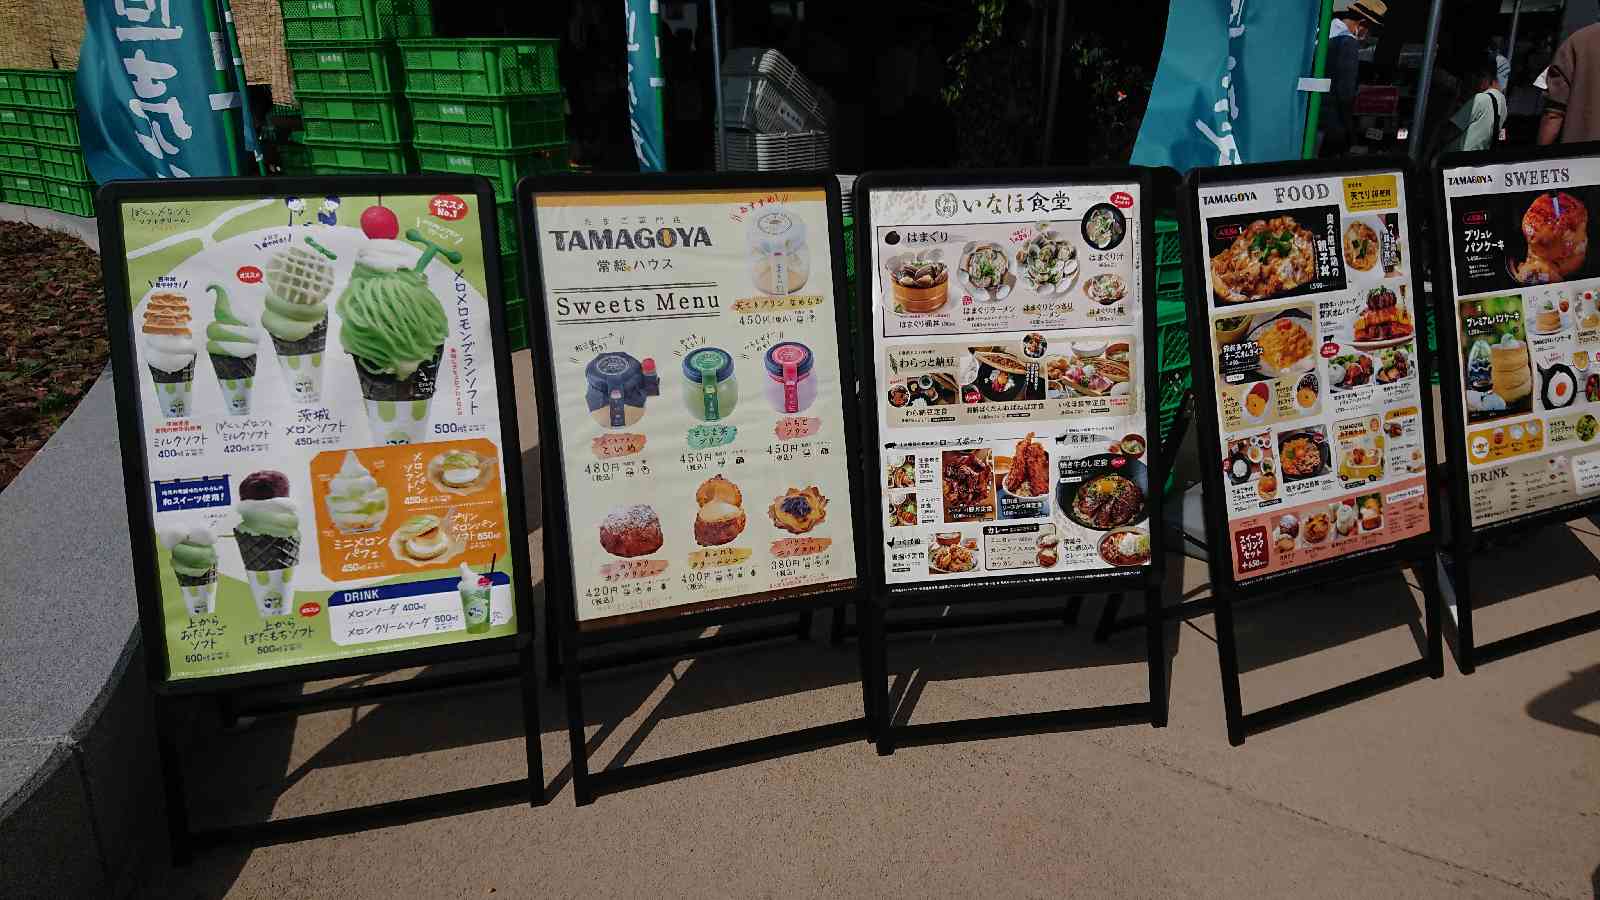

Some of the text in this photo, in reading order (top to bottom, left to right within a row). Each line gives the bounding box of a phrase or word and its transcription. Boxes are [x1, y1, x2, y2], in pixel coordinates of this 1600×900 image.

[1448, 174, 1493, 186] TAMAGOYA
[1504, 167, 1570, 188] SWEETS
[1202, 190, 1258, 205] TAMAGOYA
[1273, 183, 1331, 204] FOOD
[963, 191, 1073, 215] いなほ食堂
[437, 208, 458, 218] No.1
[548, 226, 713, 252] TAMAGOYA
[907, 232, 949, 243] はまぐり
[1464, 229, 1492, 241] ブリュレ
[1464, 240, 1505, 253] パンケーキ
[1089, 253, 1124, 262] はまぐり汁
[1316, 239, 1331, 276] 親子丼
[556, 293, 720, 316] Sweets Menu
[1466, 313, 1521, 328] プレミアムパンケーキ
[899, 357, 955, 369] わらっと納豆
[286, 420, 347, 436] メロンソフト
[153, 433, 208, 447] ミルクソフト
[224, 430, 272, 441] ミルクソフト
[1471, 466, 1510, 484] DRINK
[988, 526, 1009, 535] カレー
[1240, 532, 1263, 543] スイーツ
[334, 537, 386, 550] ミニメロン
[1241, 539, 1264, 551] ドリンク
[345, 549, 378, 560] パフェ
[1243, 549, 1262, 559] セット
[344, 589, 380, 603] DRINK
[348, 604, 400, 619] メロンソーダ
[187, 616, 219, 629] 上から
[263, 618, 296, 632] 上から
[348, 617, 430, 636] メロンクリームソーダ
[181, 626, 227, 641] おだんご
[244, 627, 314, 646] ぼたもちソフト
[192, 639, 217, 650] ソフト
